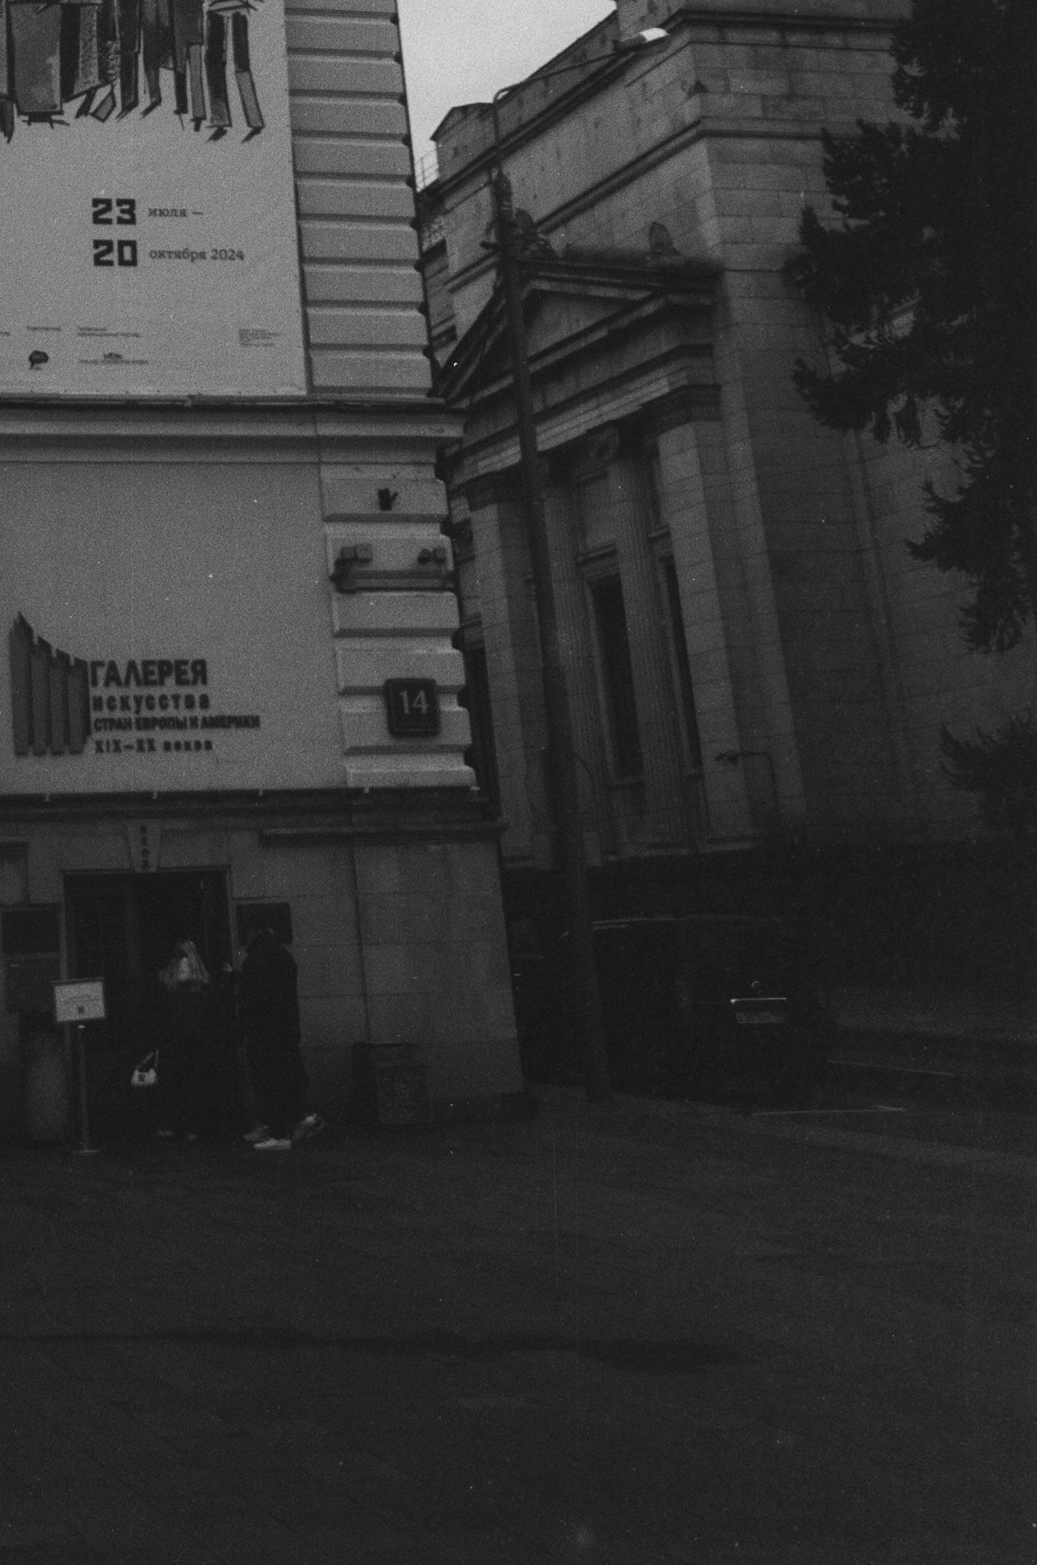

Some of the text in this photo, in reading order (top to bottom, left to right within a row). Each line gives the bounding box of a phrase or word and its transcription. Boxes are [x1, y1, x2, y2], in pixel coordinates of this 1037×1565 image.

[92, 198, 137, 225] 23
[148, 207, 187, 218] июля
[93, 239, 245, 267] 20 октября 2024
[90, 659, 208, 687] ГАЛЕРЕЯ
[92, 693, 210, 714] искусства
[399, 690, 430, 714] 14
[93, 714, 261, 732] СТРАН ЕВРОПЫ И АМЕРИКИ
